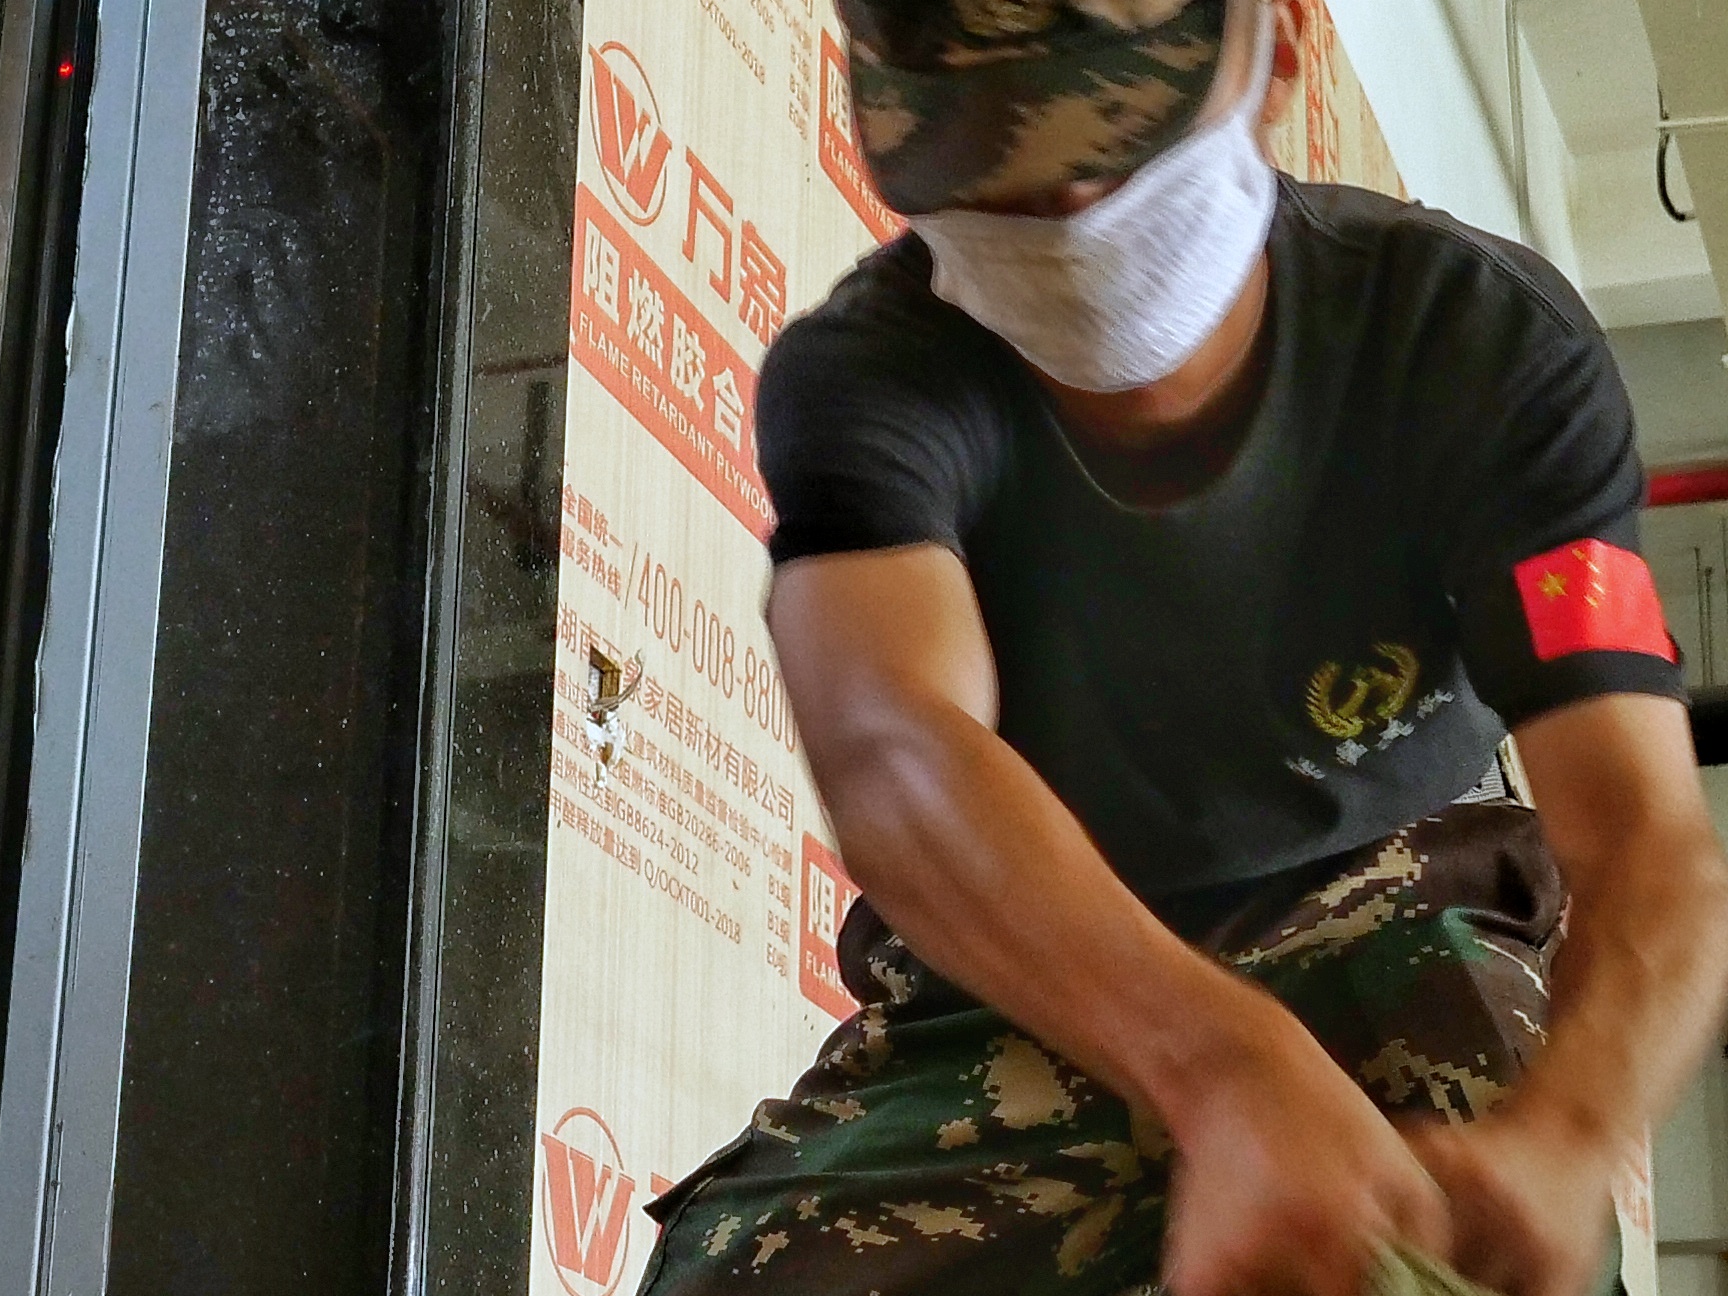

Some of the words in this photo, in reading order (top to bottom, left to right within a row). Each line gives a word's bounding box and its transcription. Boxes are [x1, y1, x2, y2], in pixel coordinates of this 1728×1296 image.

[682, 145, 788, 348] 万象
[579, 309, 630, 380] FLAME
[629, 357, 716, 466] RETARDANT
[581, 216, 759, 470] 阻燃胶合
[562, 483, 623, 548] 全国统一
